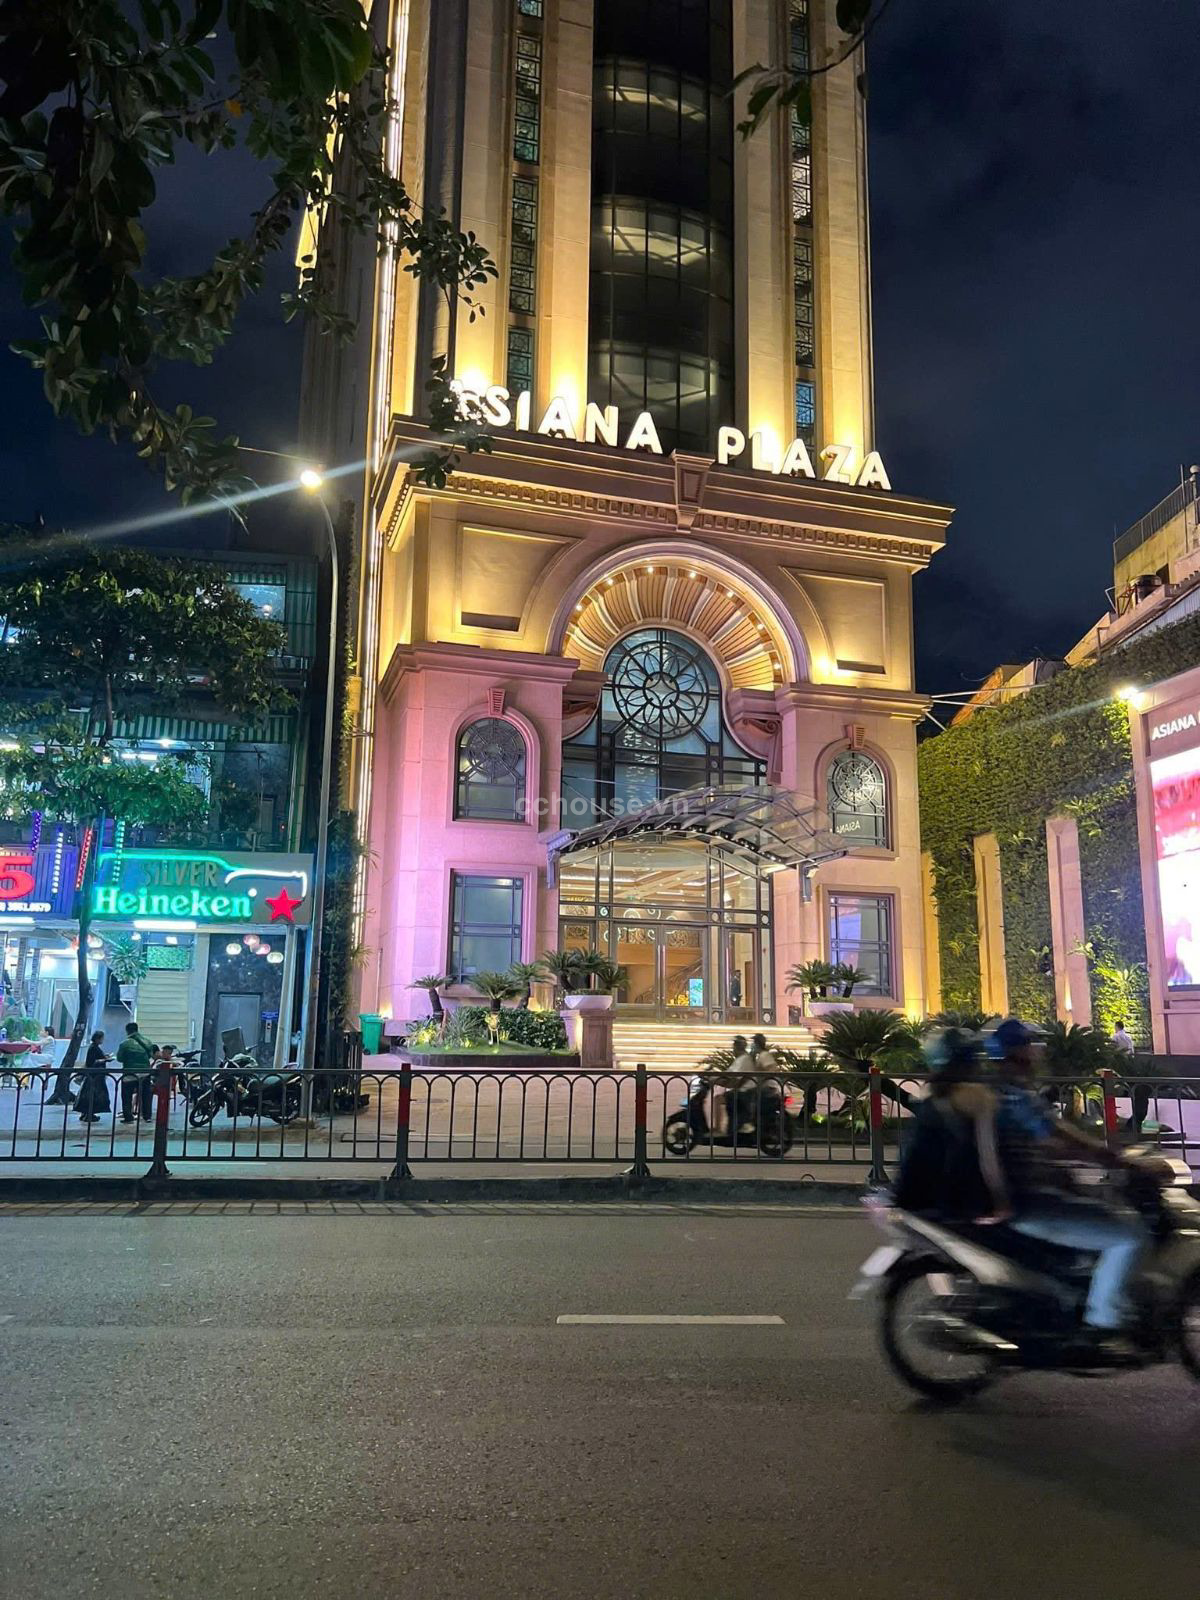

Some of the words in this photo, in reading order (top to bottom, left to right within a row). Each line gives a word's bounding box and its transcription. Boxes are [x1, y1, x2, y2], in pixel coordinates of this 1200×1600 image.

[718, 426, 892, 491] PLAZA
[1152, 713, 1197, 740] ASIANA
[0, 856, 36, 899] 5
[140, 861, 218, 887] SILVER
[93, 886, 252, 917] Heineken
